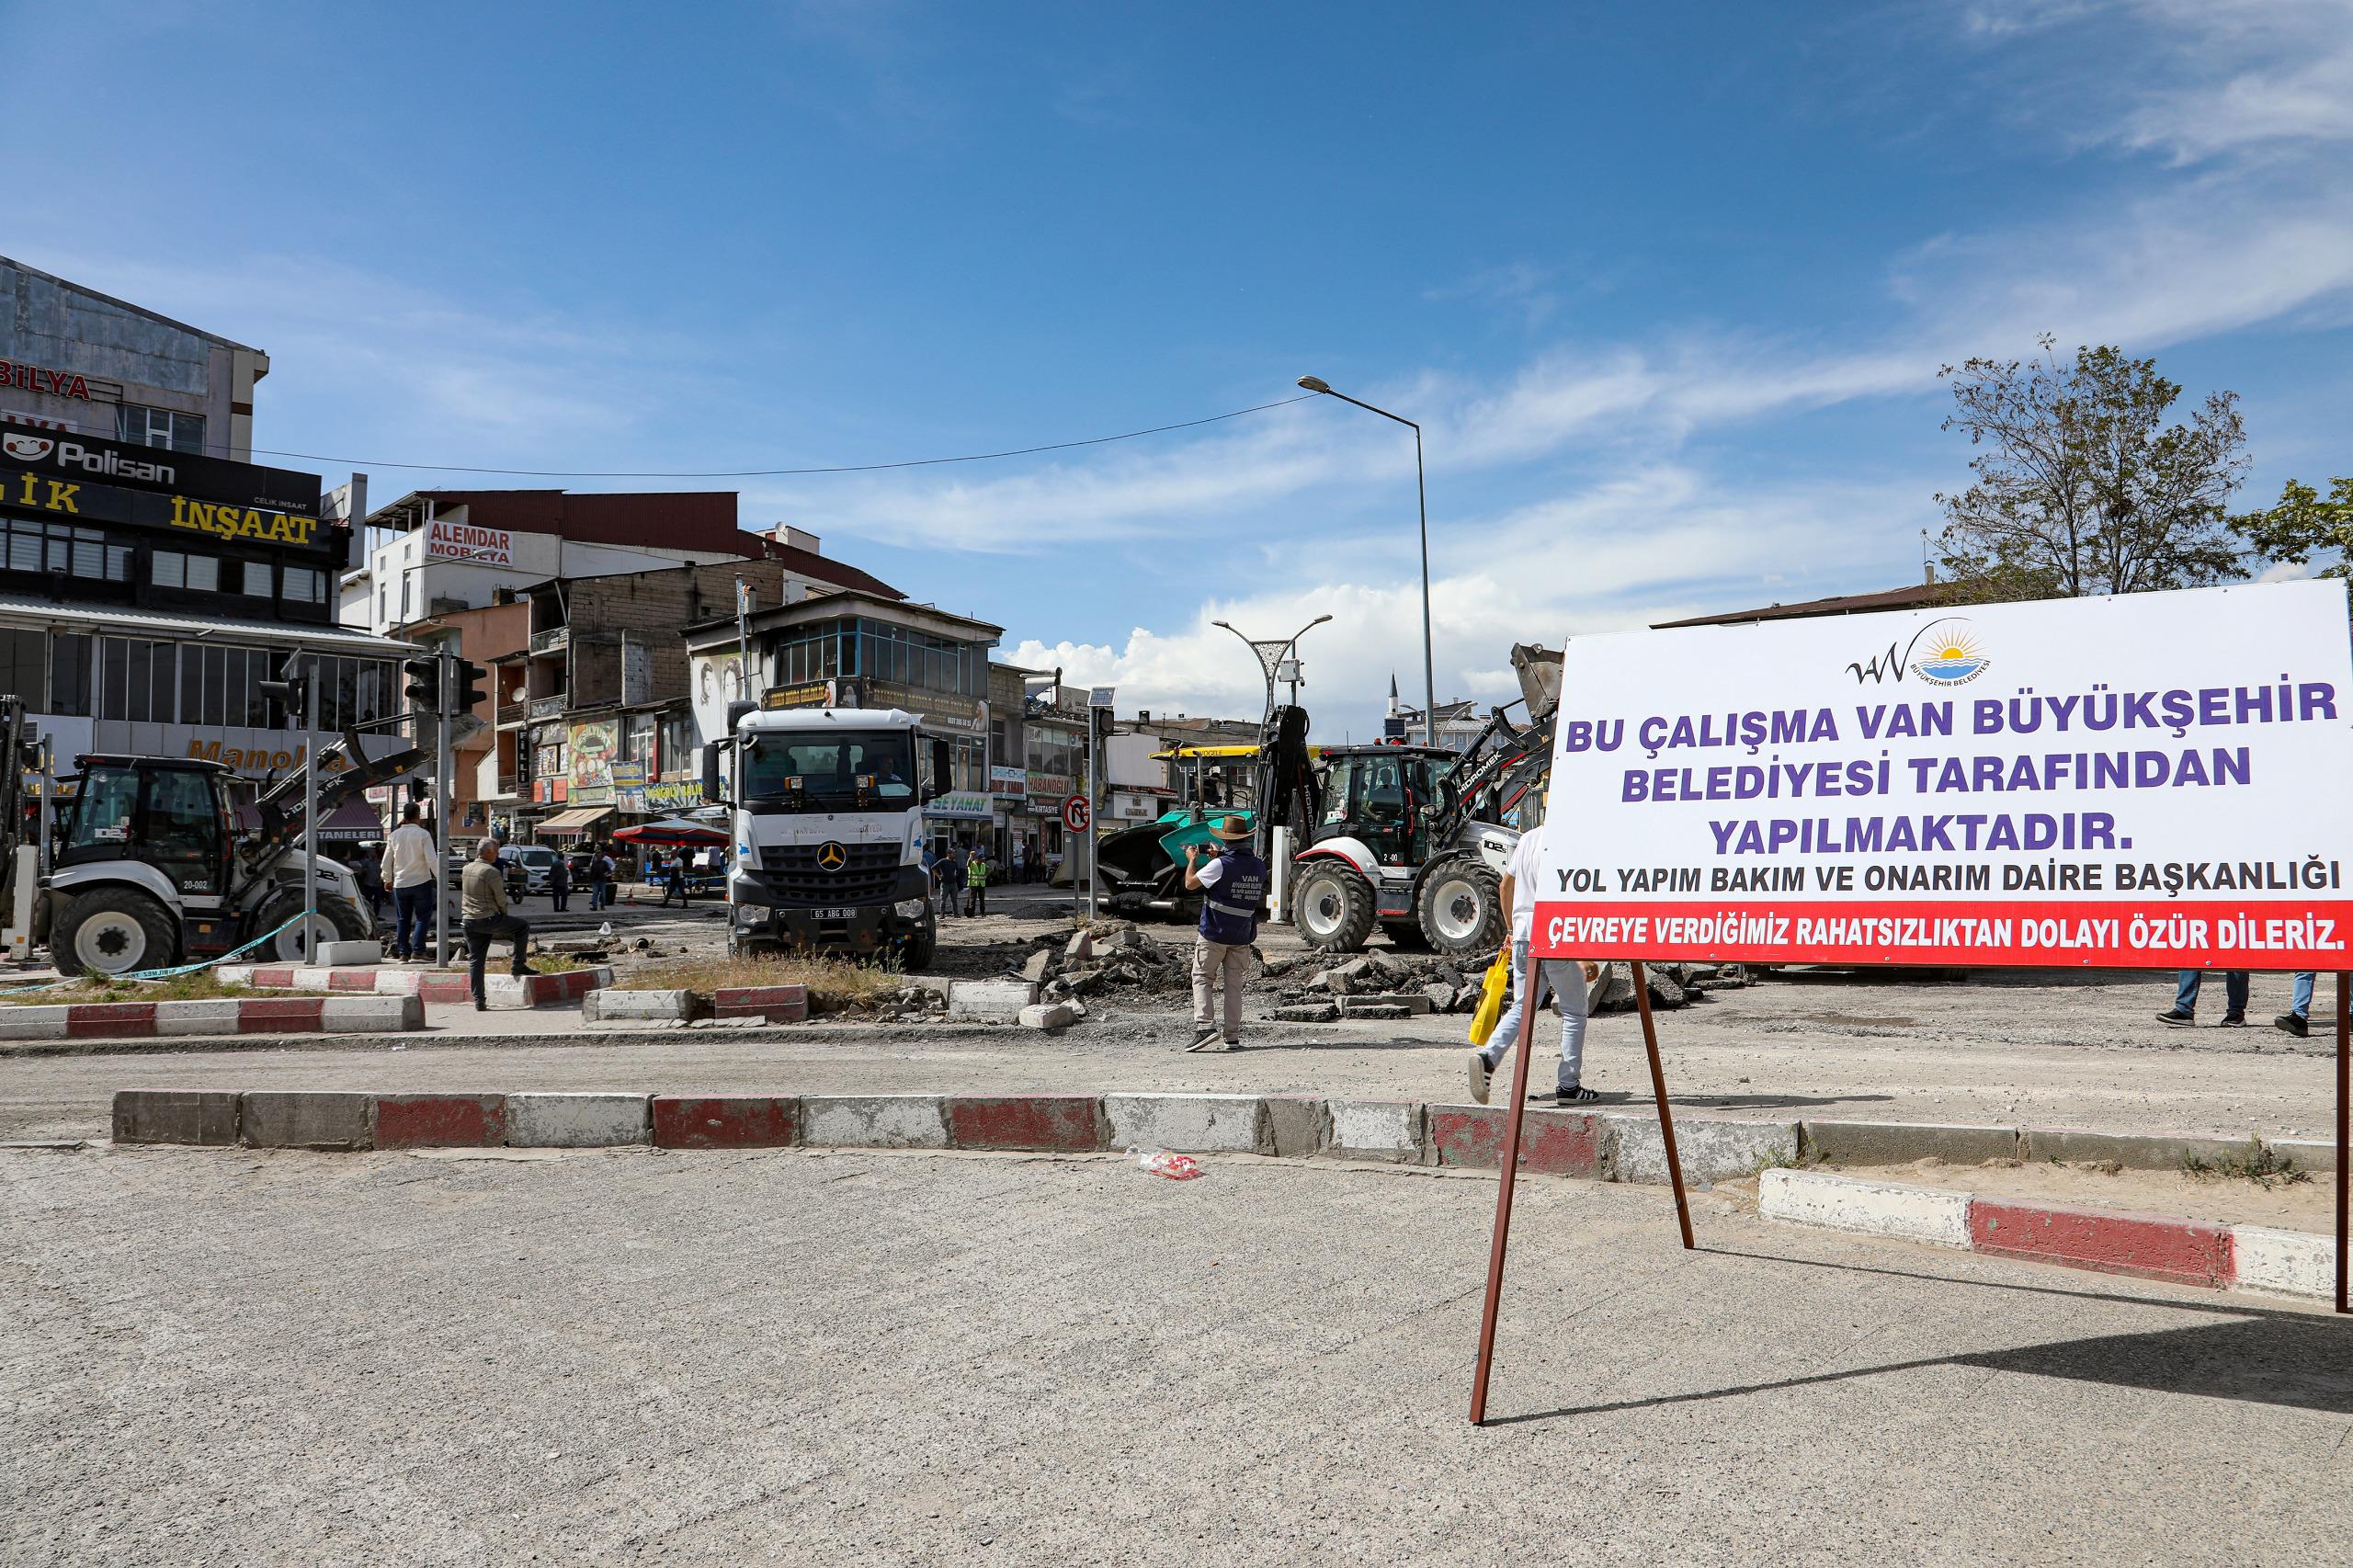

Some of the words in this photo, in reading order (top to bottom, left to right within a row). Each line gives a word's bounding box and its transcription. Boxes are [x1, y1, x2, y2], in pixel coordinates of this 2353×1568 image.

[58, 441, 175, 485] Polisan
[0, 472, 80, 514] İK
[170, 494, 317, 544] İNŞAAT
[430, 522, 509, 551] ALEMDAR
[1910, 664, 1952, 687] BÜYÜKŞEHİR
[1953, 659, 1992, 687] BELEDİYESİ
[1565, 719, 1625, 753] BU
[1639, 708, 1839, 759] ÇALIŞMA
[1856, 701, 1953, 740] VAN
[1973, 674, 2337, 738] BÜYÜKŞEHİR
[188, 740, 347, 773] Manola
[1457, 750, 1503, 796] HİDROMEK
[1622, 749, 1891, 802] BELEDİYESİ
[1908, 747, 2251, 793] TARAFINDAN
[933, 796, 987, 812] SEYAHAT
[317, 830, 381, 839] TANELERİ
[1709, 812, 2132, 855] YAPILMAKTADIR.
[184, 881, 207, 890] 20-002
[1557, 868, 1607, 892] YOL
[1618, 868, 1701, 892] YAPIM
[1711, 866, 1805, 892] BAKIM
[1815, 866, 1854, 892] VE
[1864, 864, 1990, 892] ONARIM
[2003, 858, 2102, 891] DAİRE
[2115, 854, 2340, 897] BAŞKANLIĞI
[814, 910, 824, 918] 65
[827, 909, 840, 918] ABG
[1548, 916, 1648, 949] ÇEVREYE
[1654, 911, 1790, 946] VERDİĞİMİZ
[1801, 917, 2012, 948] RAHATSIZLIKTAN
[2021, 919, 2120, 949] DOLAYI
[2128, 913, 2210, 949] ÖZÜR
[2217, 912, 2345, 950] DİLERİZ.
